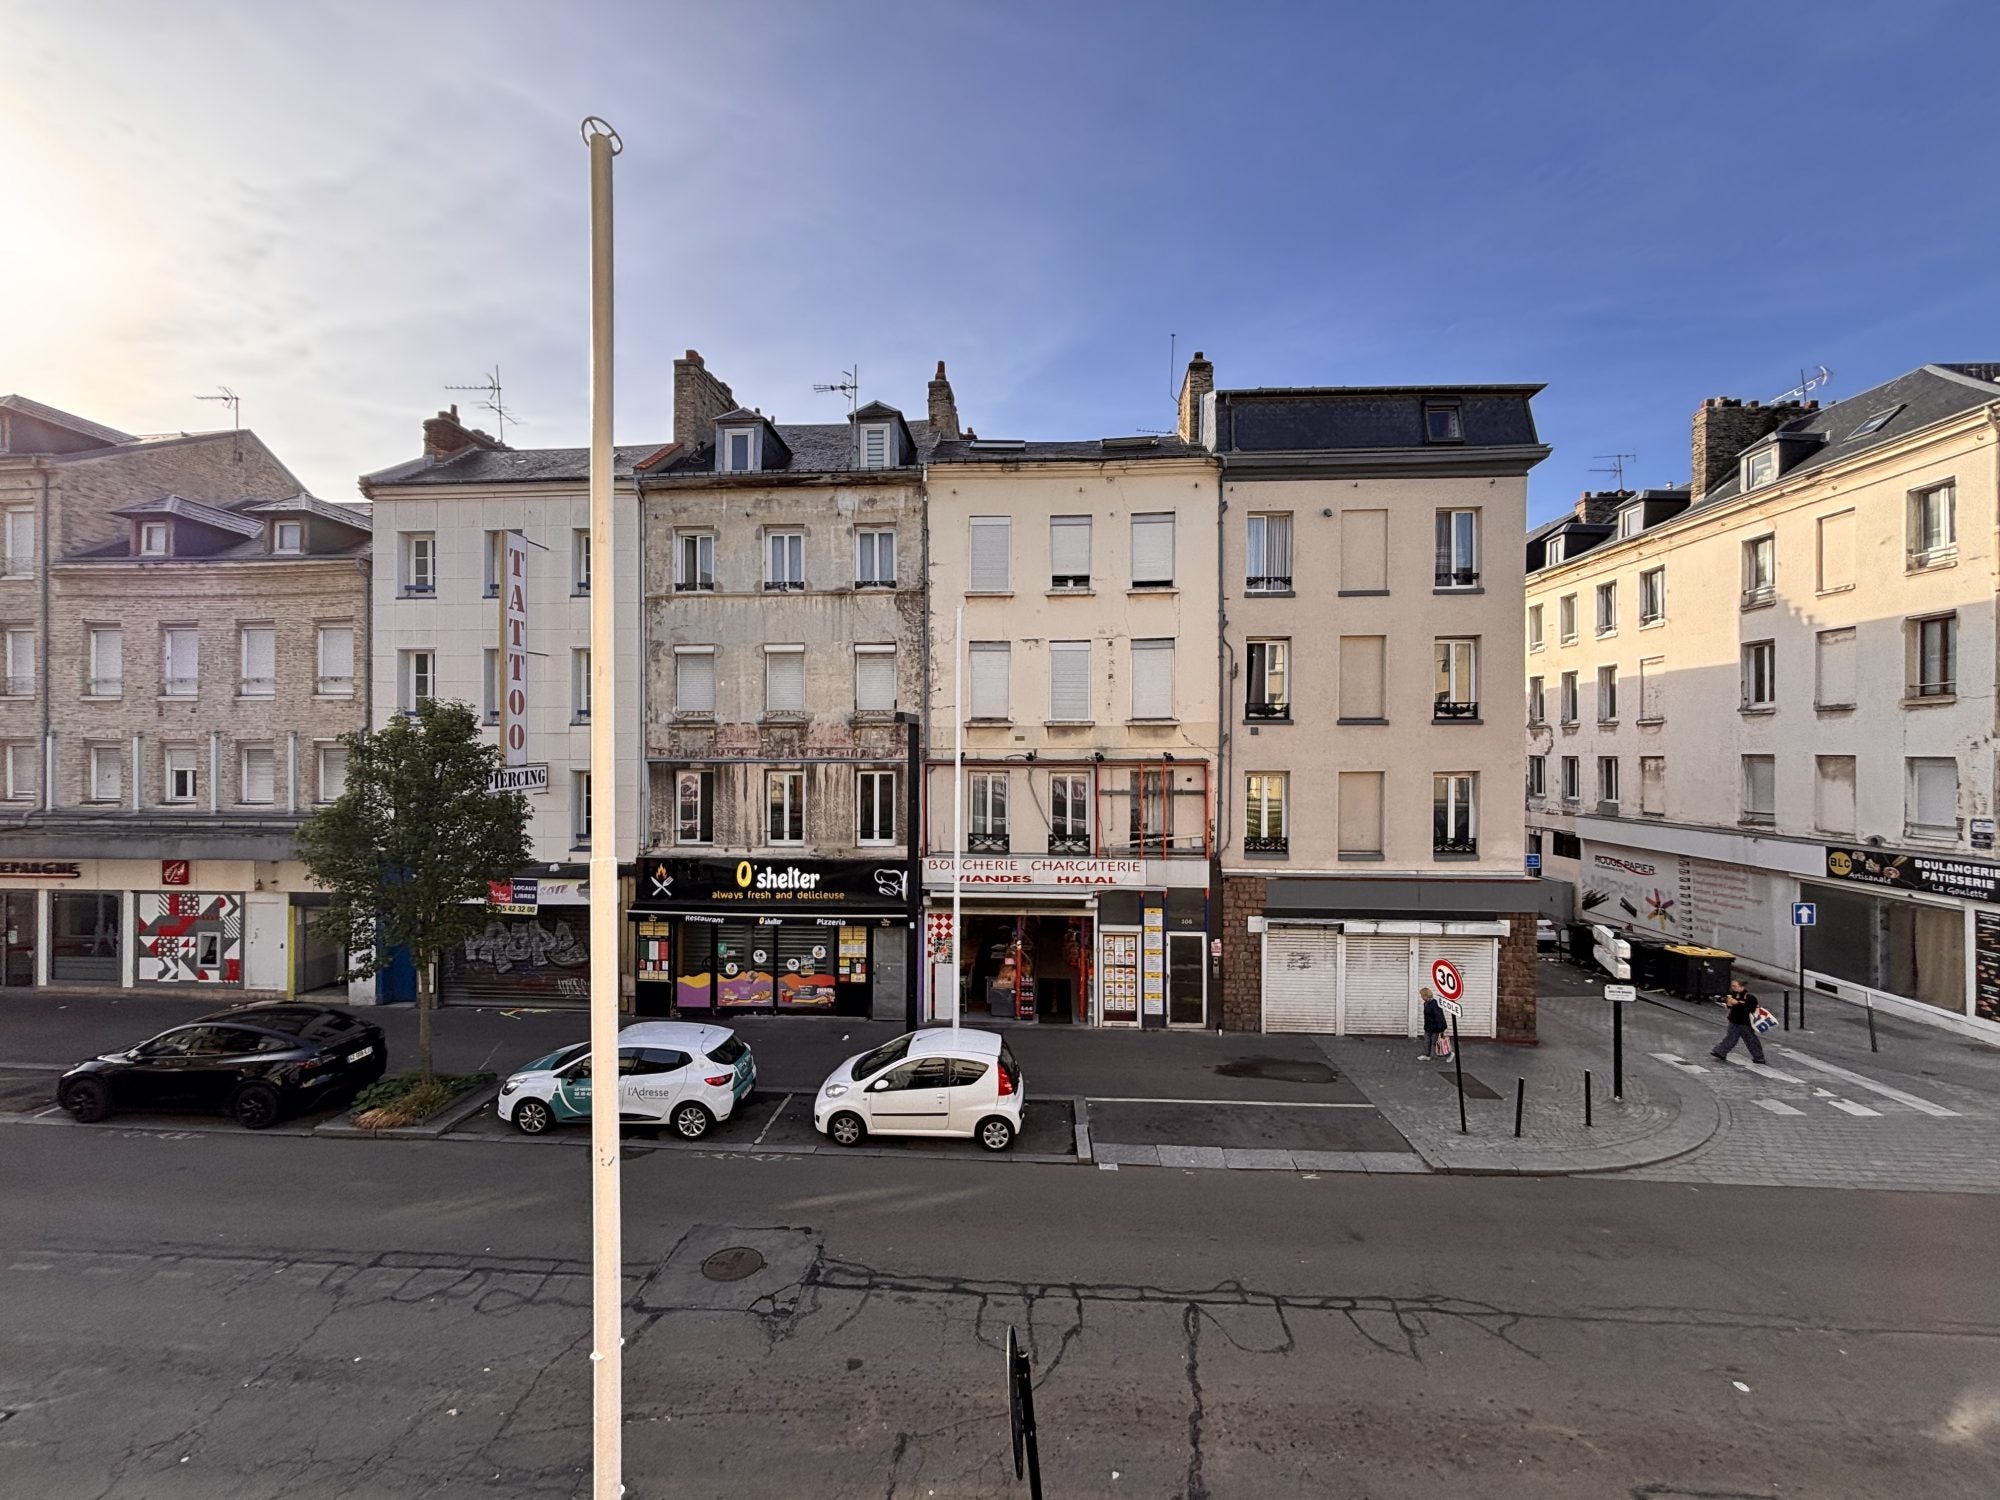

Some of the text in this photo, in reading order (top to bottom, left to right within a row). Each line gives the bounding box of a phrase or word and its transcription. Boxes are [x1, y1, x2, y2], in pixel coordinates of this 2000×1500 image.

[508, 547, 525, 750] TATTOO
[487, 769, 545, 791] PIERCING
[1595, 854, 1622, 868] ROUGE
[1624, 860, 1655, 874] PAPIER
[1830, 857, 1851, 869] BLC
[1914, 859, 2000, 878] BOULANGERIE
[1057, 876, 1117, 884] HALAL
[1849, 872, 1892, 884] Artisanale
[712, 891, 743, 899] always
[748, 891, 771, 899] fresh
[775, 891, 793, 899] and
[1932, 884, 1988, 899] La Goulette
[685, 915, 724, 924] Restaurant
[1437, 968, 1456, 990] 30
